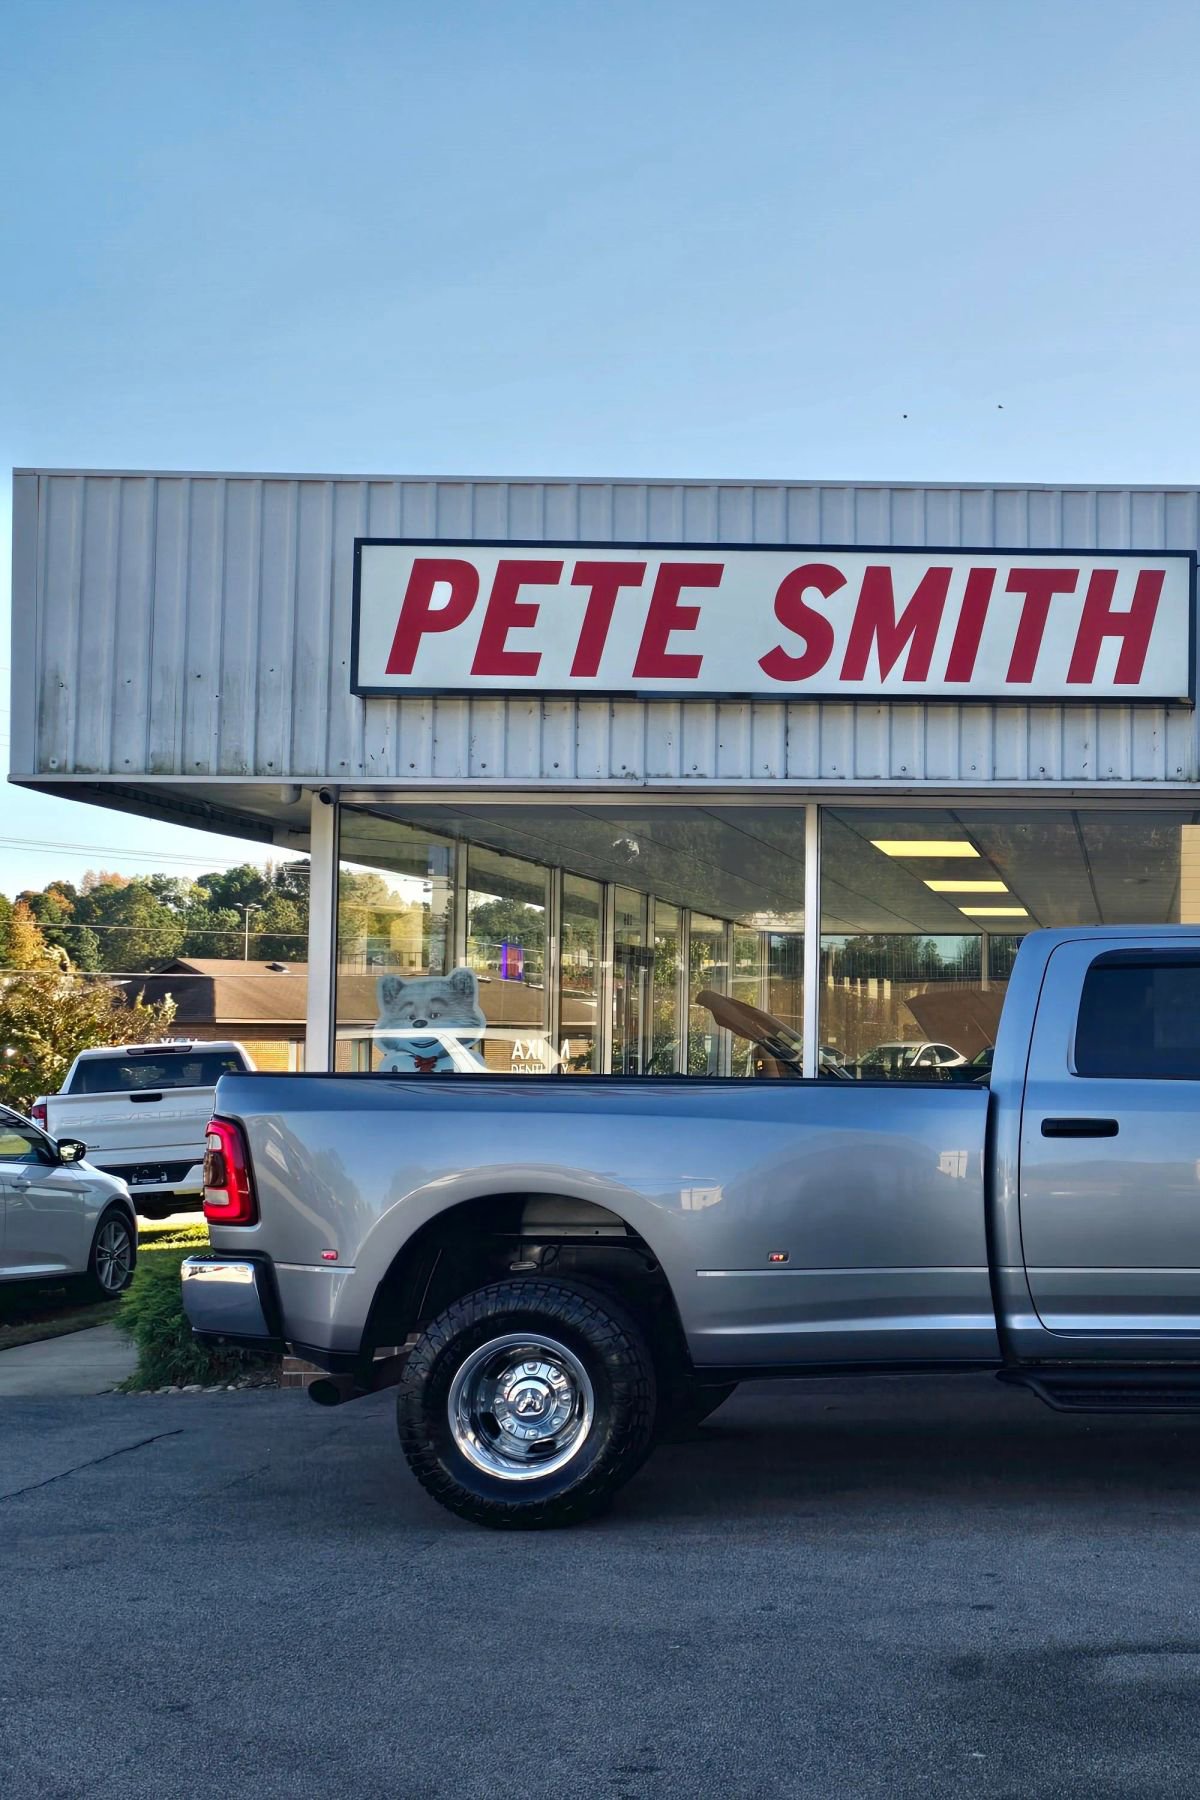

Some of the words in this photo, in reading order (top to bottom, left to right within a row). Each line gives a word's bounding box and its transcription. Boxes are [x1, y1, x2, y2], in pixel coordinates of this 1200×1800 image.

[385, 558, 724, 678] PETE
[757, 563, 1166, 685] SMITH
[511, 1038, 570, 1060] AXIM
